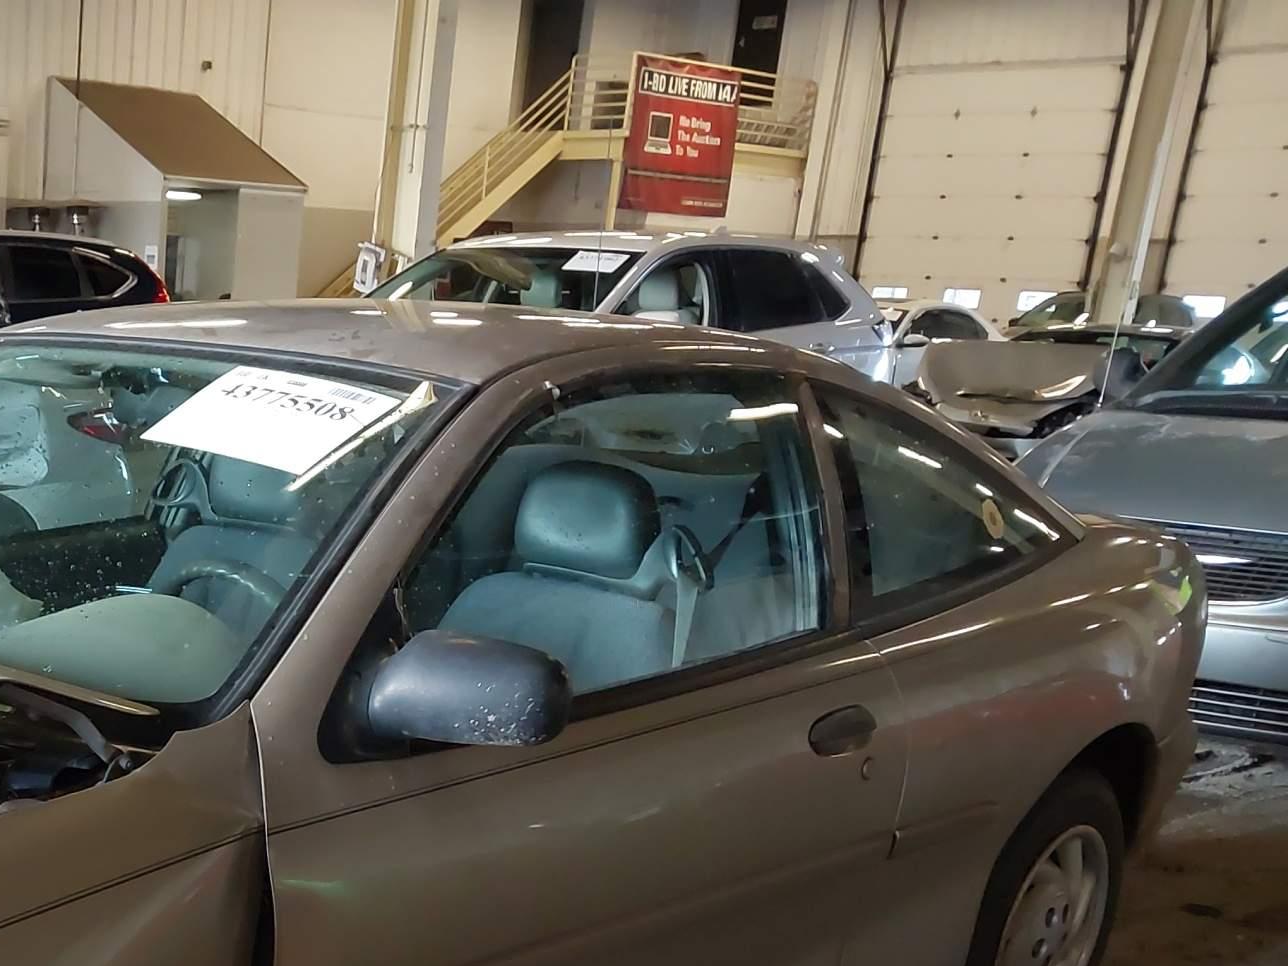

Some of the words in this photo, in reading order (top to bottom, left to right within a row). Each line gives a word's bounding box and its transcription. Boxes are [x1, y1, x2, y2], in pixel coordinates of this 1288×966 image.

[668, 76, 689, 97] LIVE
[689, 80, 717, 101] FROM
[691, 117, 712, 133] Bring
[221, 383, 355, 420] 43775508
